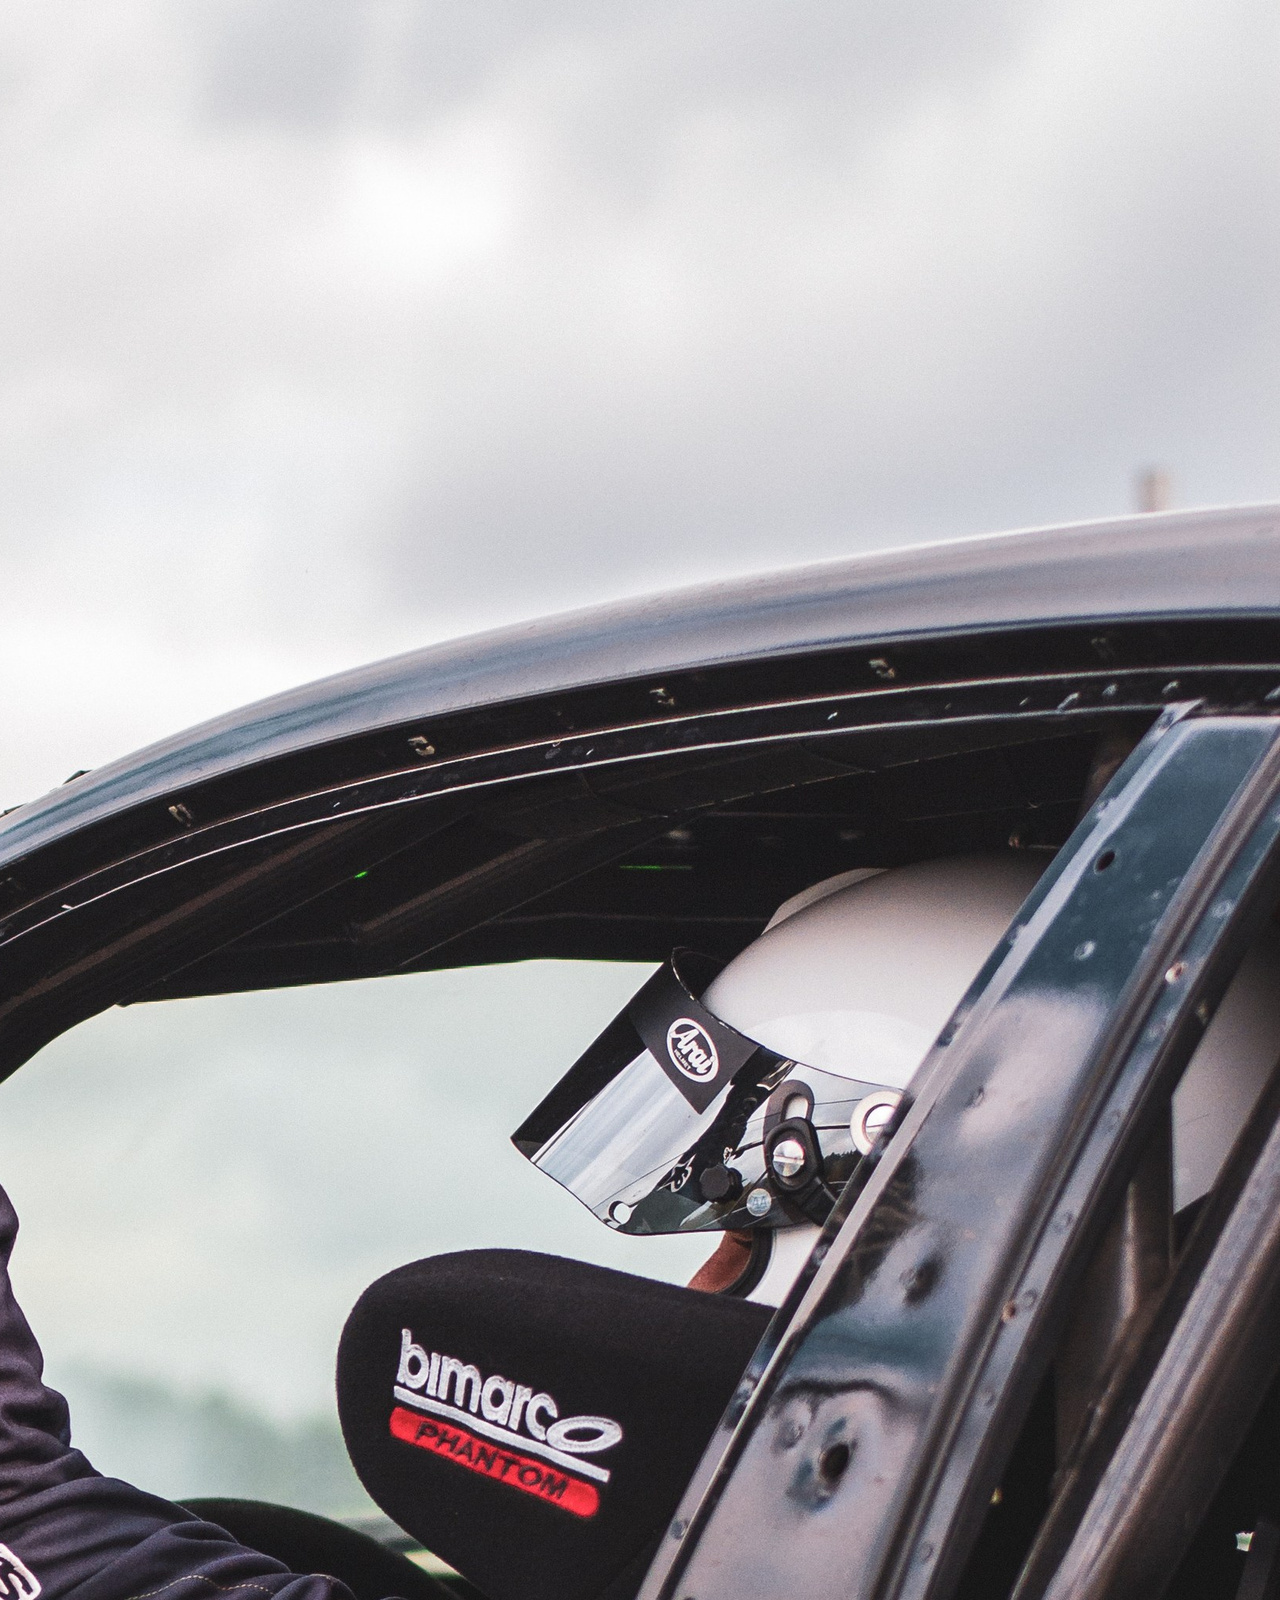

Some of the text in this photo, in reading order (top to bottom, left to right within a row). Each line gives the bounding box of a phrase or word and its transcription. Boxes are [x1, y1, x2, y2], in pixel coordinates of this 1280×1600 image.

[669, 1028, 716, 1074] Arai
[396, 1328, 623, 1453] bimarco
[413, 1420, 570, 1500] PHANTOM
